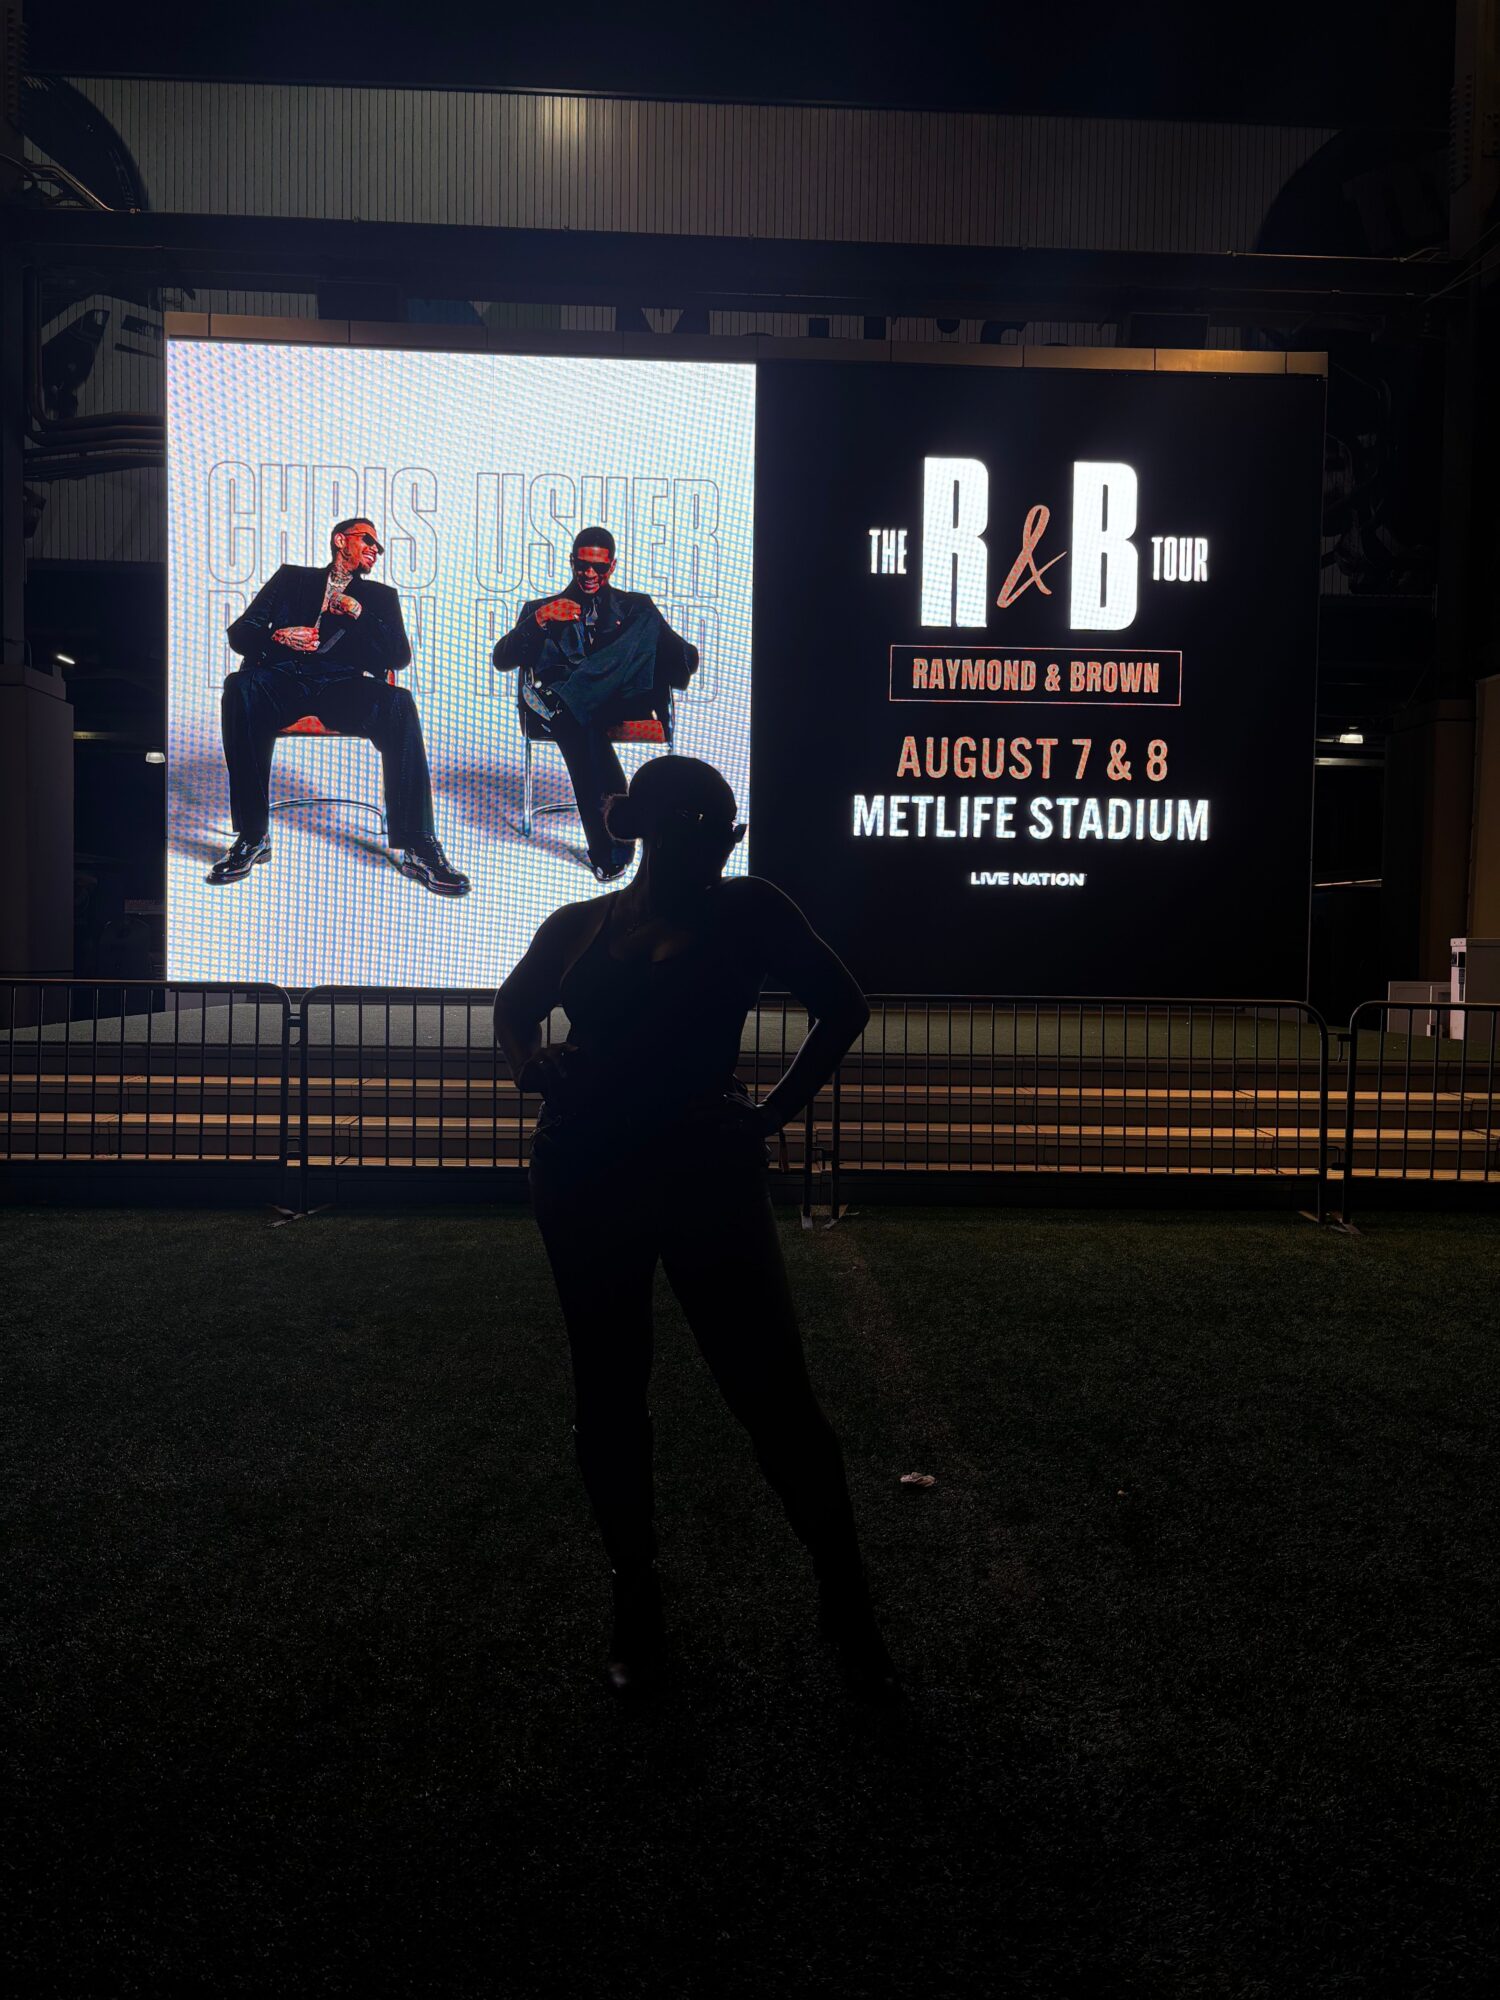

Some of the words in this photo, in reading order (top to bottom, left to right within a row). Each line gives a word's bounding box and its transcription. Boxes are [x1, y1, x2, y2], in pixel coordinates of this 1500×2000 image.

[208, 461, 437, 589] CHRIS
[476, 472, 719, 598] USHER
[869, 529, 907, 574] THE
[921, 457, 989, 628] R
[996, 504, 1067, 608] &
[1070, 461, 1138, 630] B
[1151, 536, 1208, 582] TOUR
[912, 658, 1036, 691] RAYMOND
[1044, 663, 1061, 692] &
[1070, 661, 1160, 693] BROWN
[897, 736, 1058, 779] AUGUST
[1072, 739, 1092, 780] 7
[1107, 738, 1132, 781] &
[1147, 739, 1168, 782] 8
[853, 795, 1017, 839] METLIFE
[1029, 797, 1209, 841] STADIUM
[971, 872, 1009, 885] LIVE
[1013, 873, 1085, 886] NATION
